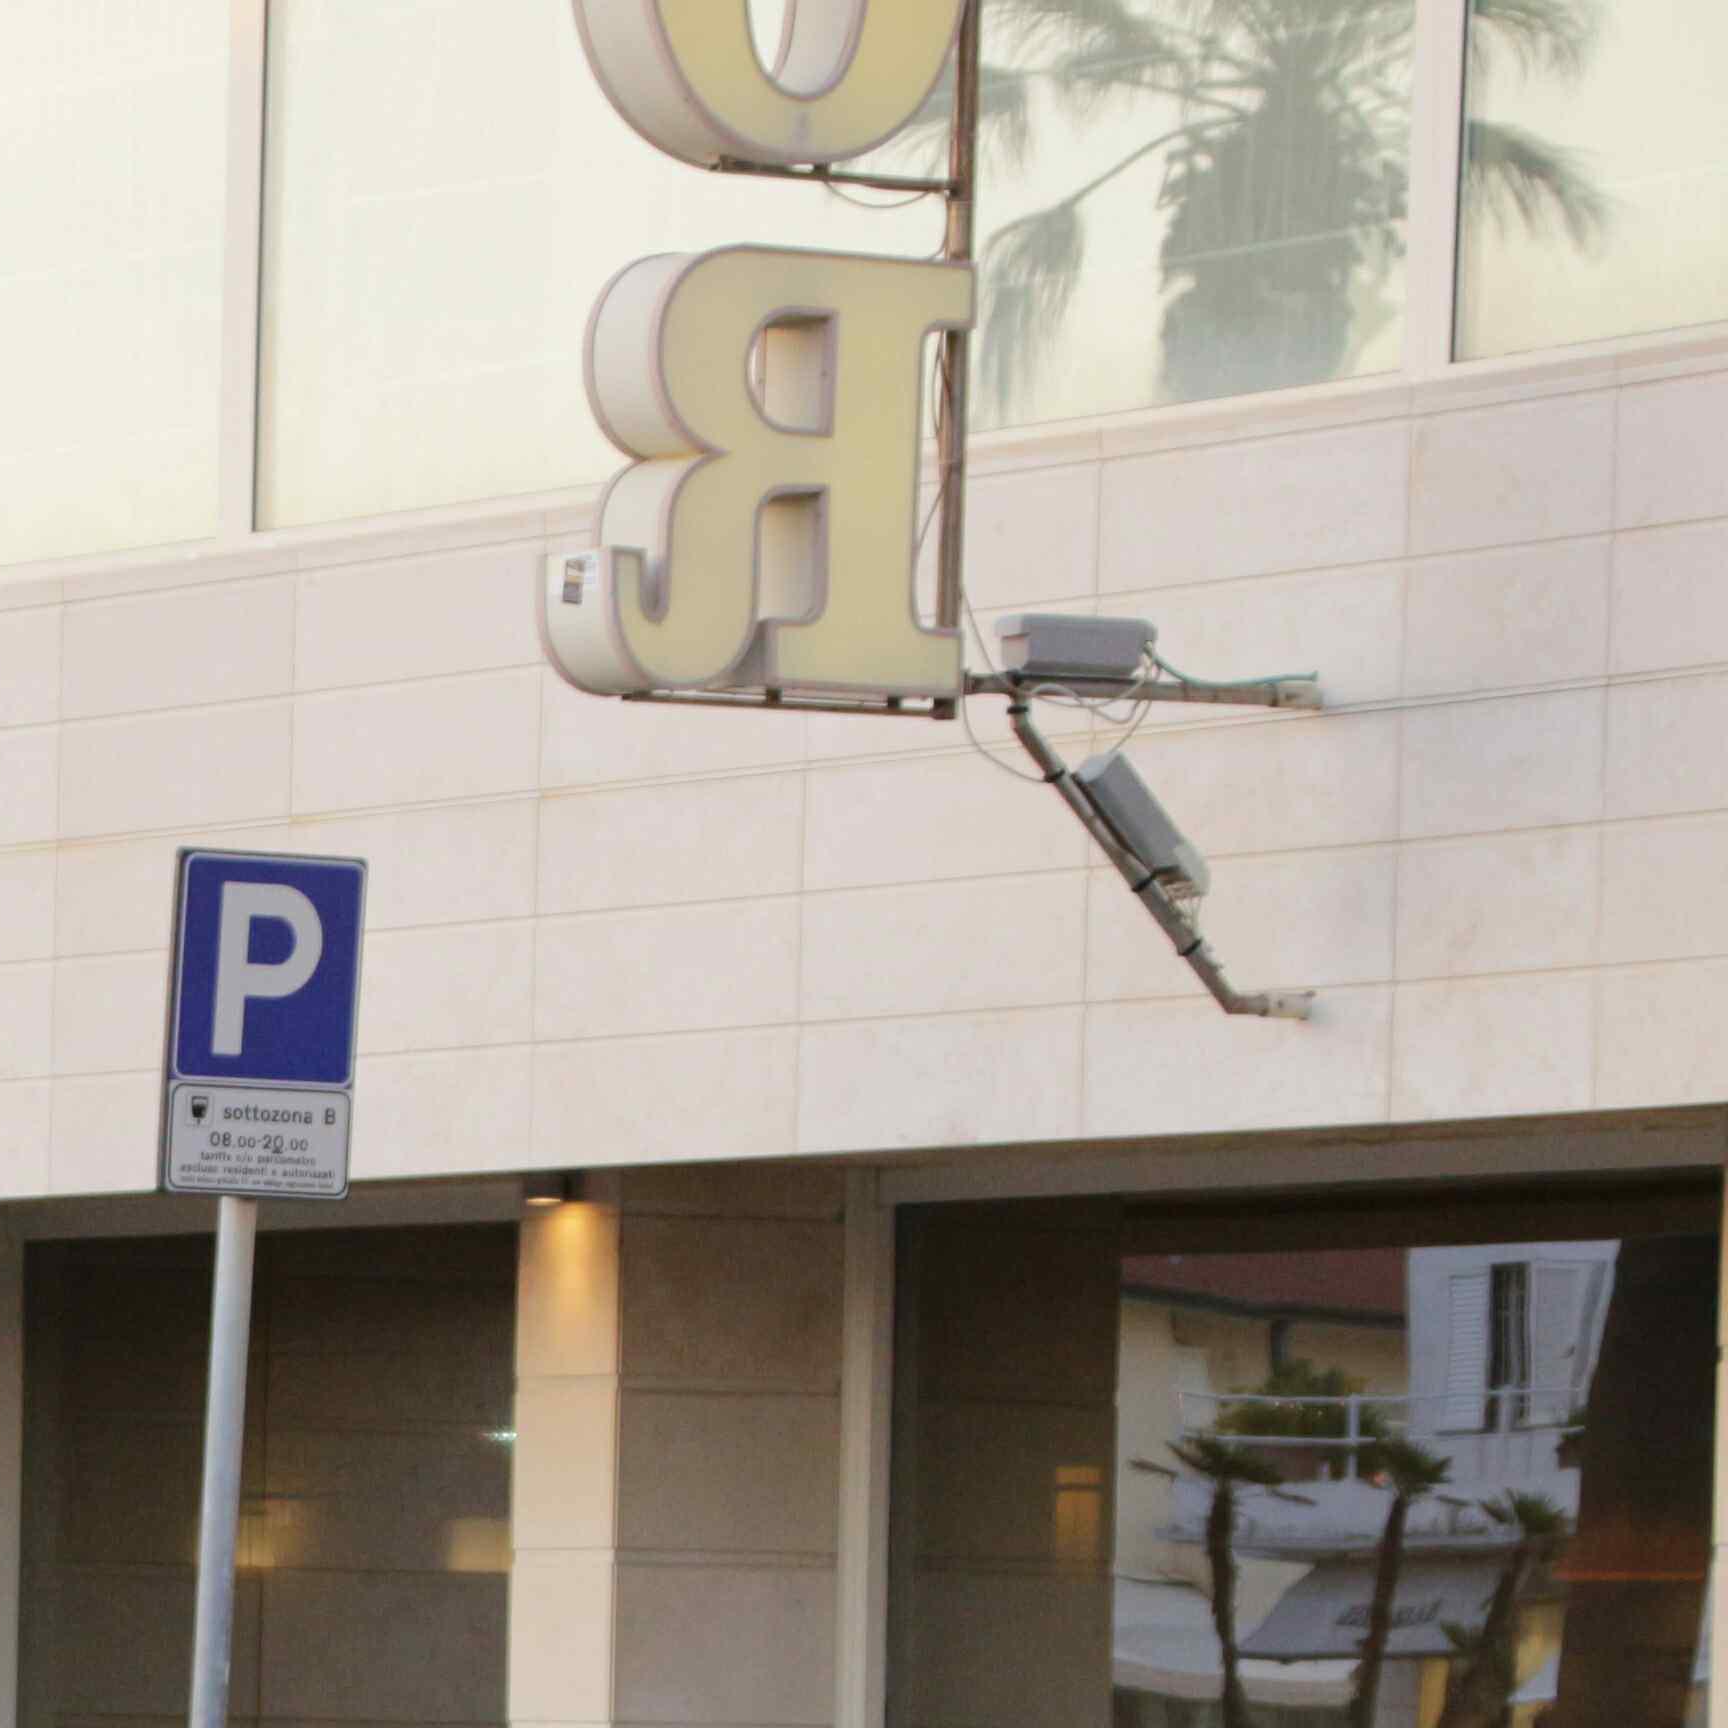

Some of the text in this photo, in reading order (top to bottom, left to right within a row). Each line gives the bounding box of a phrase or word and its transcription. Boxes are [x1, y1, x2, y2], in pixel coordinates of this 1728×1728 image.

[211, 880, 324, 1056] P
[223, 1105, 337, 1125] sottozona B
